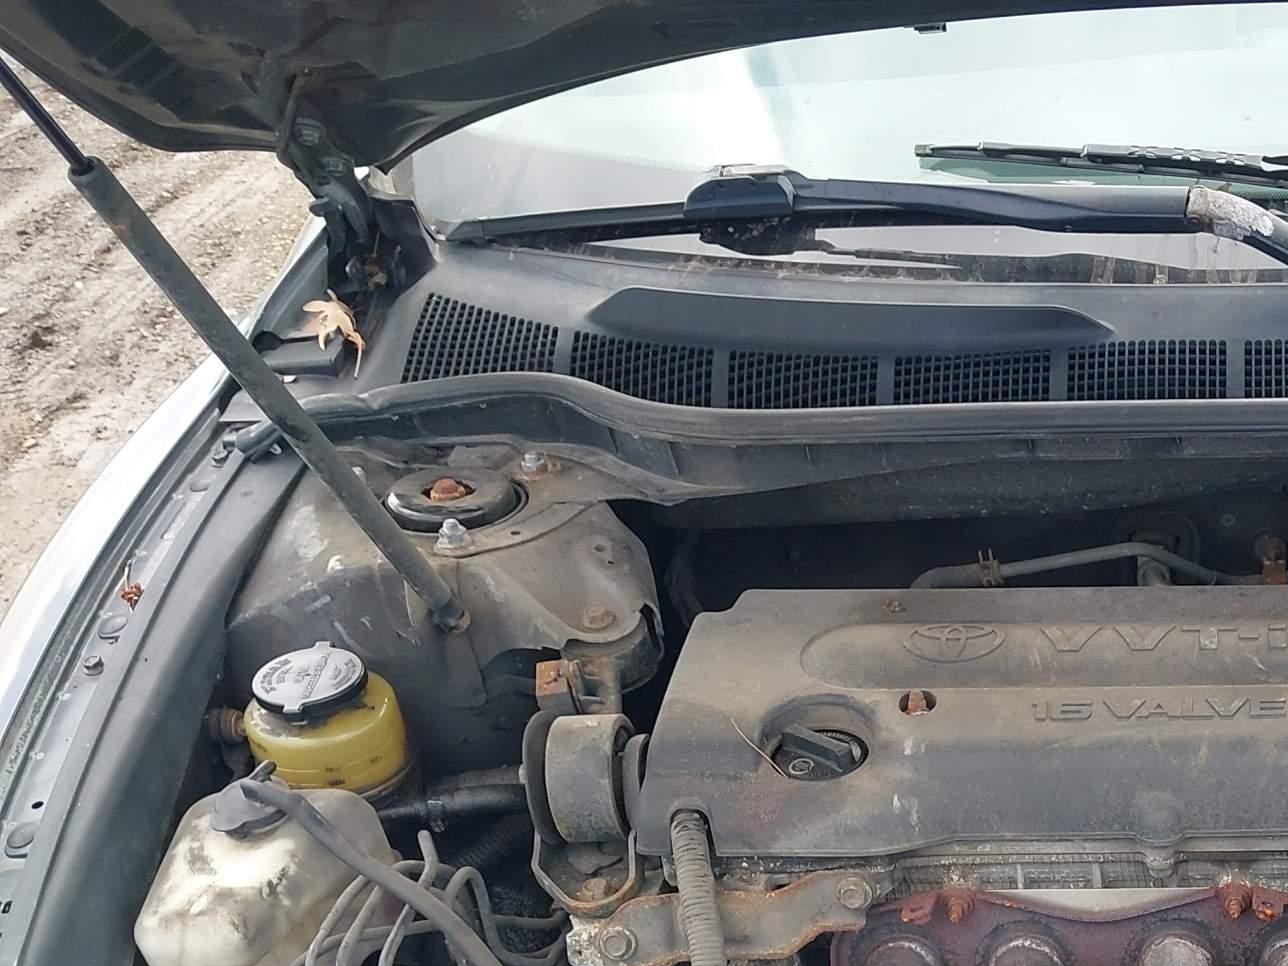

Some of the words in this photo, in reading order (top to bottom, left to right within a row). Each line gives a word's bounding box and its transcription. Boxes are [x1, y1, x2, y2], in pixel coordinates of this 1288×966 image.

[1039, 624, 1287, 652] VVT-i
[1031, 698, 1093, 721] 16
[1102, 698, 1287, 720] VALVE
